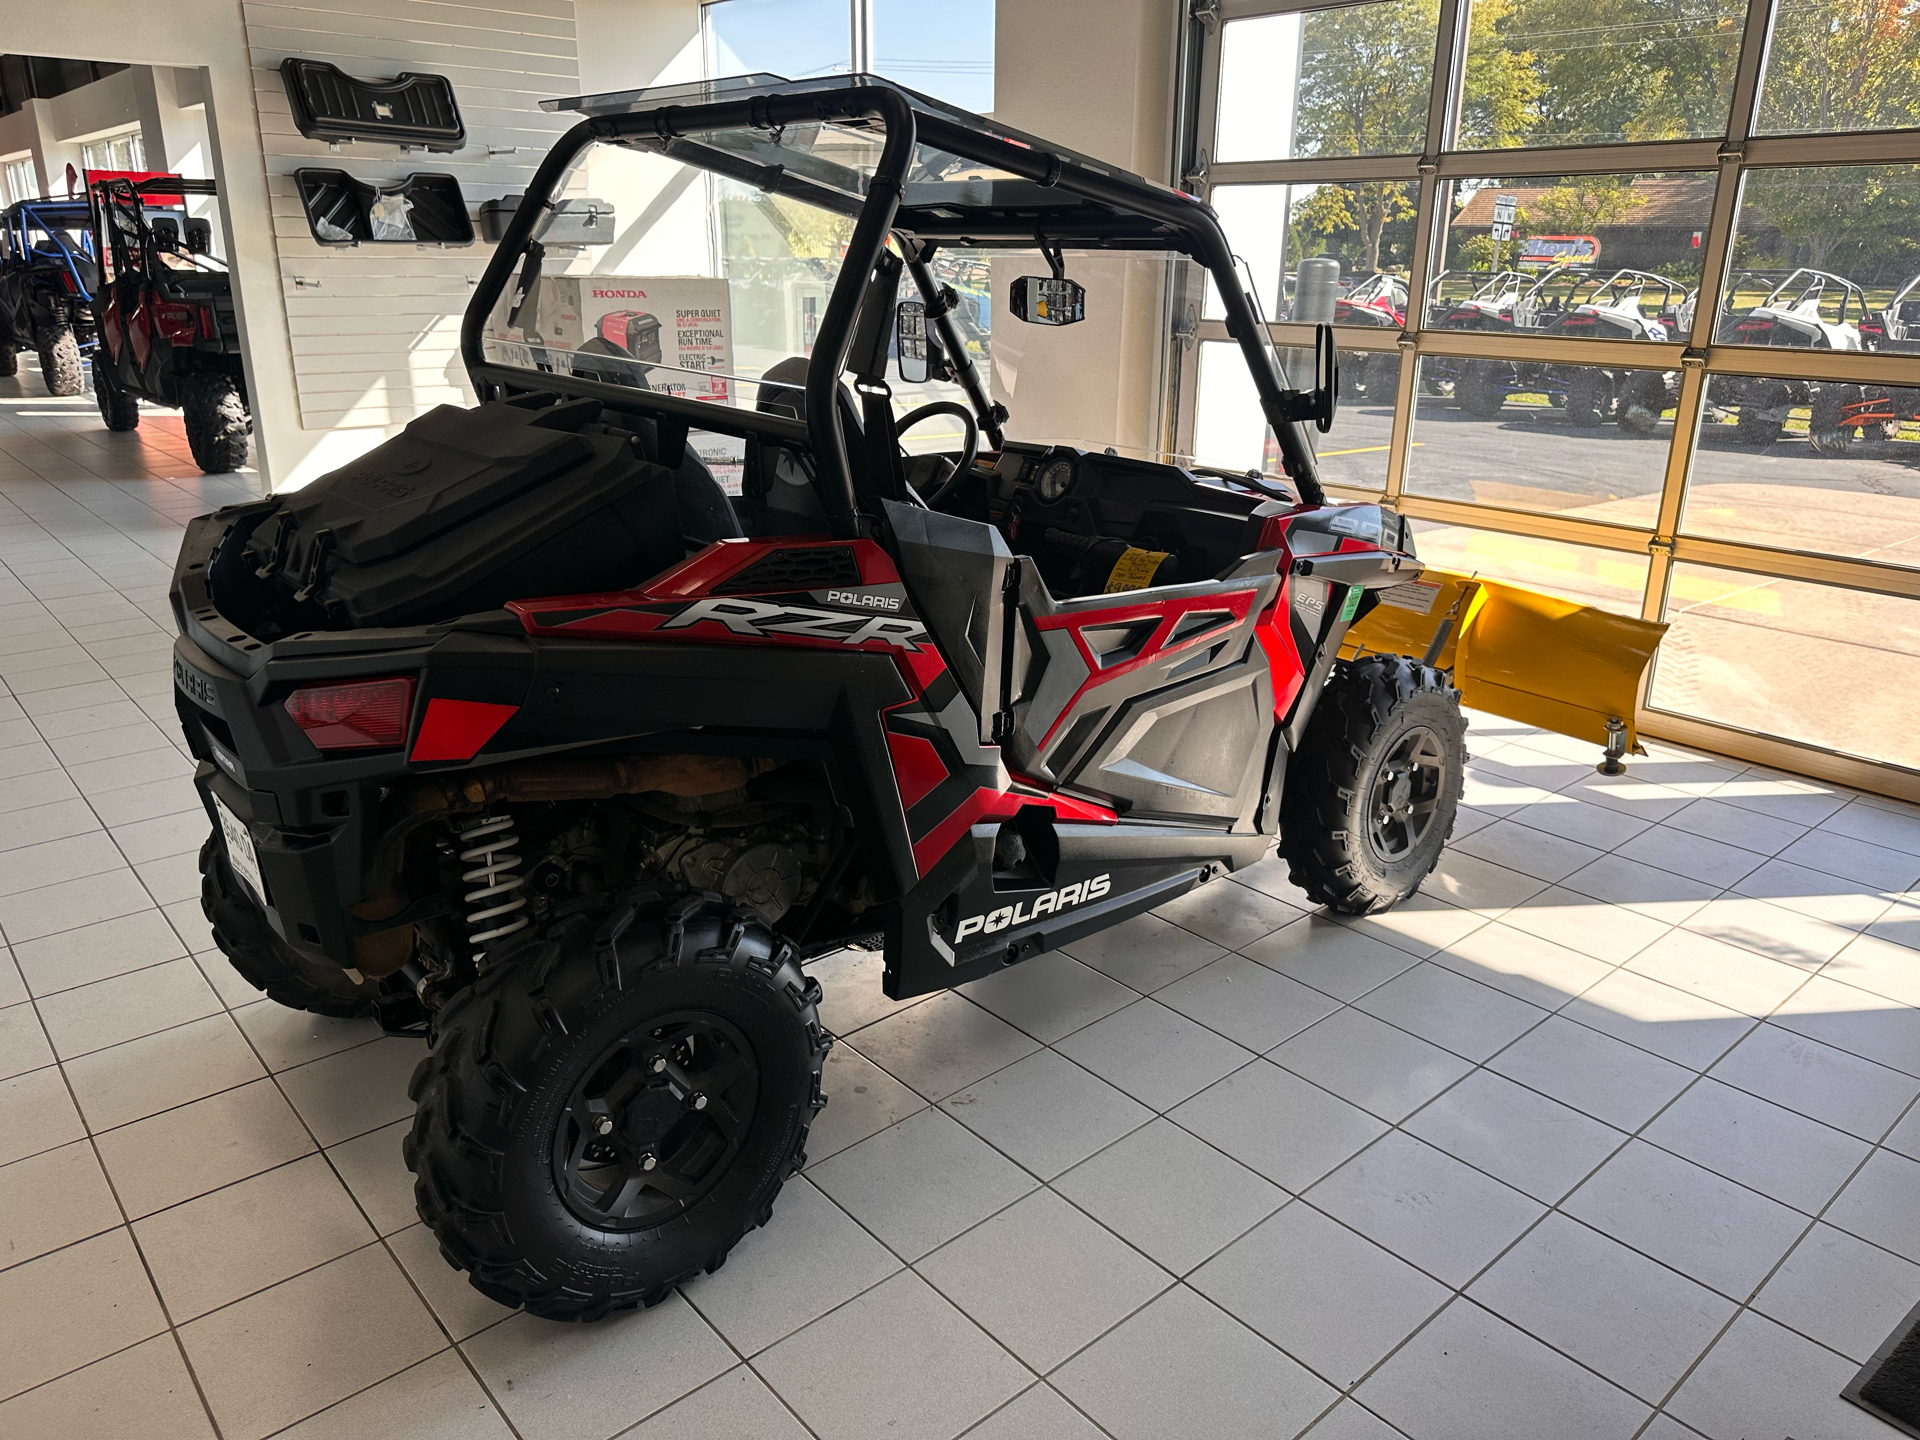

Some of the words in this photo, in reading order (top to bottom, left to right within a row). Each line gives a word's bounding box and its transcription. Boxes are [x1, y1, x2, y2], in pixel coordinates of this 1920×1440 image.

[1547, 251, 1594, 269] Sports
[592, 290, 647, 299] HONDA
[676, 309, 700, 318] SUPER
[700, 309, 722, 318] QUIET
[677, 329, 724, 338] EXCEPTIONAL
[678, 338, 693, 346] RUN
[694, 337, 713, 346] TIME
[679, 353, 706, 361] ELECTRIC
[679, 360, 706, 371] START
[1373, 511, 1396, 526] DOHC
[1330, 514, 1399, 548] 900
[826, 590, 900, 610] POLARIS
[1296, 593, 1325, 610] EPS
[661, 598, 927, 651] RZR
[954, 873, 1111, 944] POLARIS
